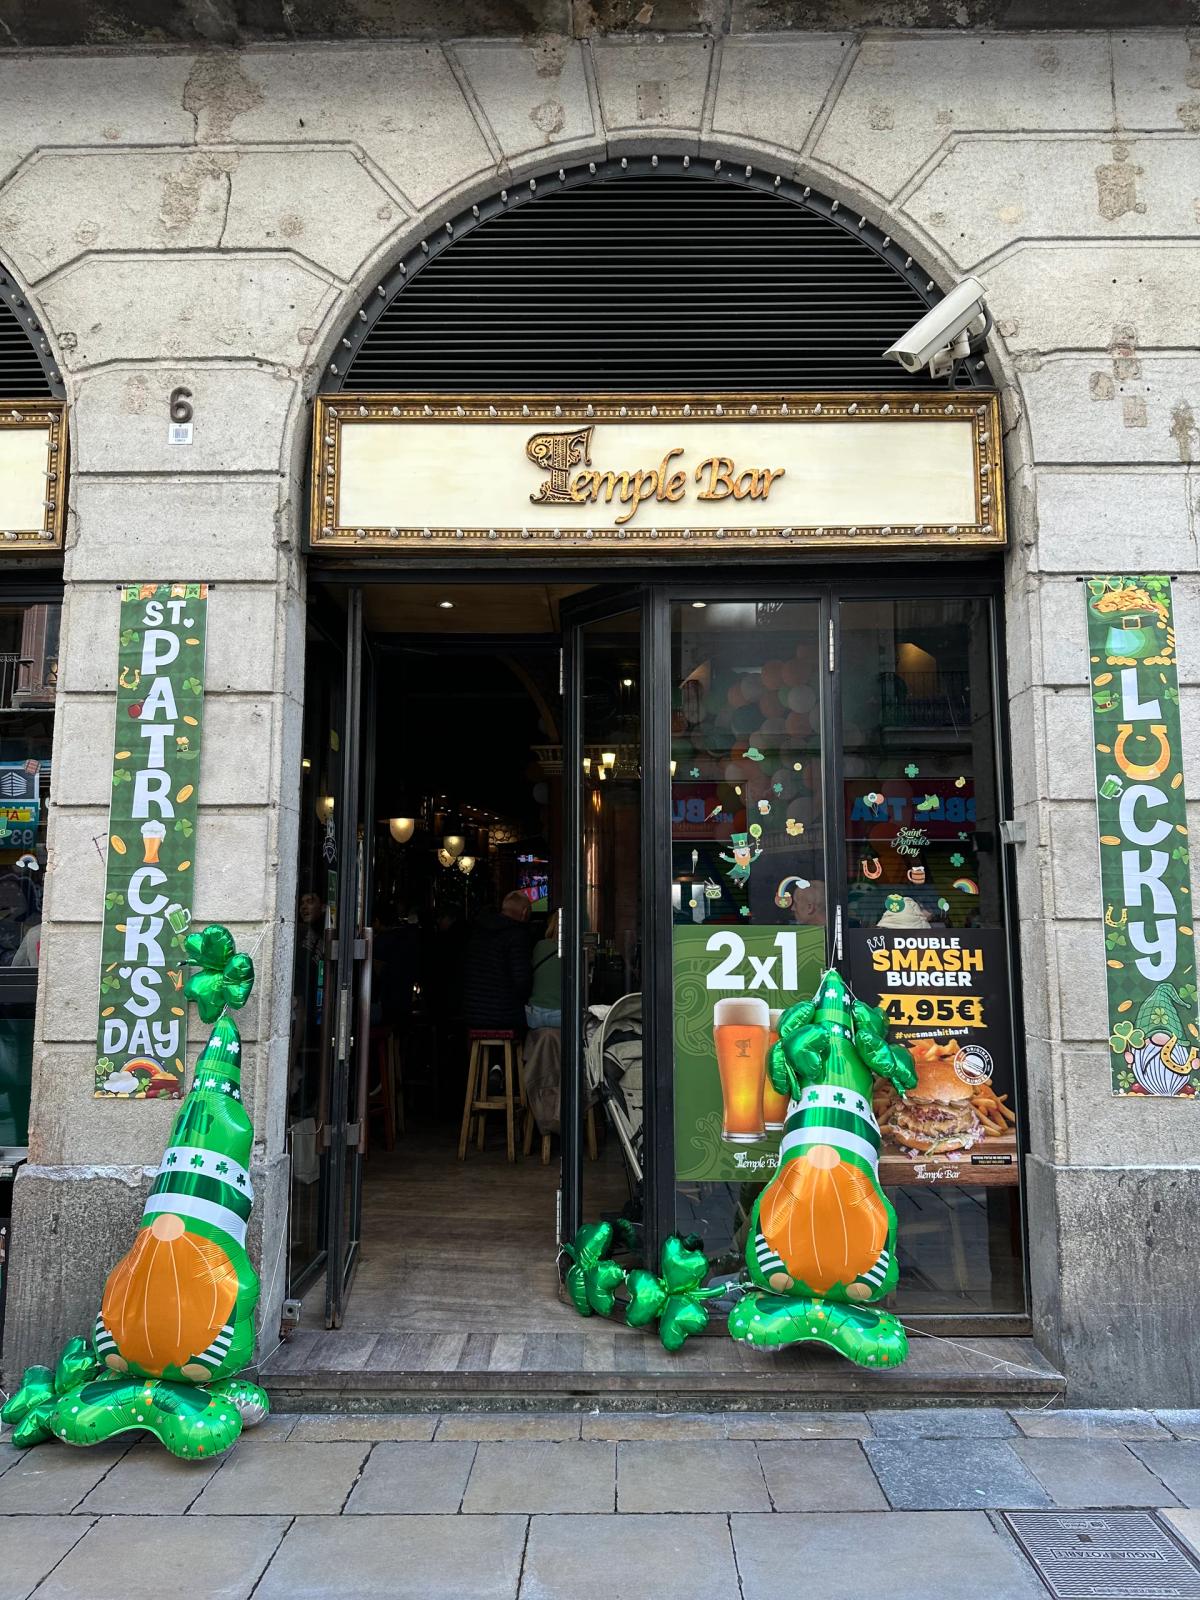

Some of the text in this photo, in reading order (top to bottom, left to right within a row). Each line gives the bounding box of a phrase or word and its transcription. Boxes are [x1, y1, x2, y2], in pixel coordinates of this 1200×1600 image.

[170, 386, 193, 424] 6
[525, 424, 786, 525] Temple Bar
[896, 827, 928, 839] Saint
[896, 845, 921, 857] Day
[893, 937, 961, 950] DOUBLE
[705, 930, 798, 991] 2x1
[872, 949, 984, 972] SMASH
[886, 971, 973, 987] BURGER
[885, 999, 975, 1026] 4,95€
[103, 1018, 180, 1058] DAY
[895, 1027, 969, 1040] #wesmashithard
[733, 1151, 780, 1173] Temple Ba
[913, 1163, 961, 1183] Temple Bar
[1054, 1550, 1157, 1559] AIGUA POTABLE
